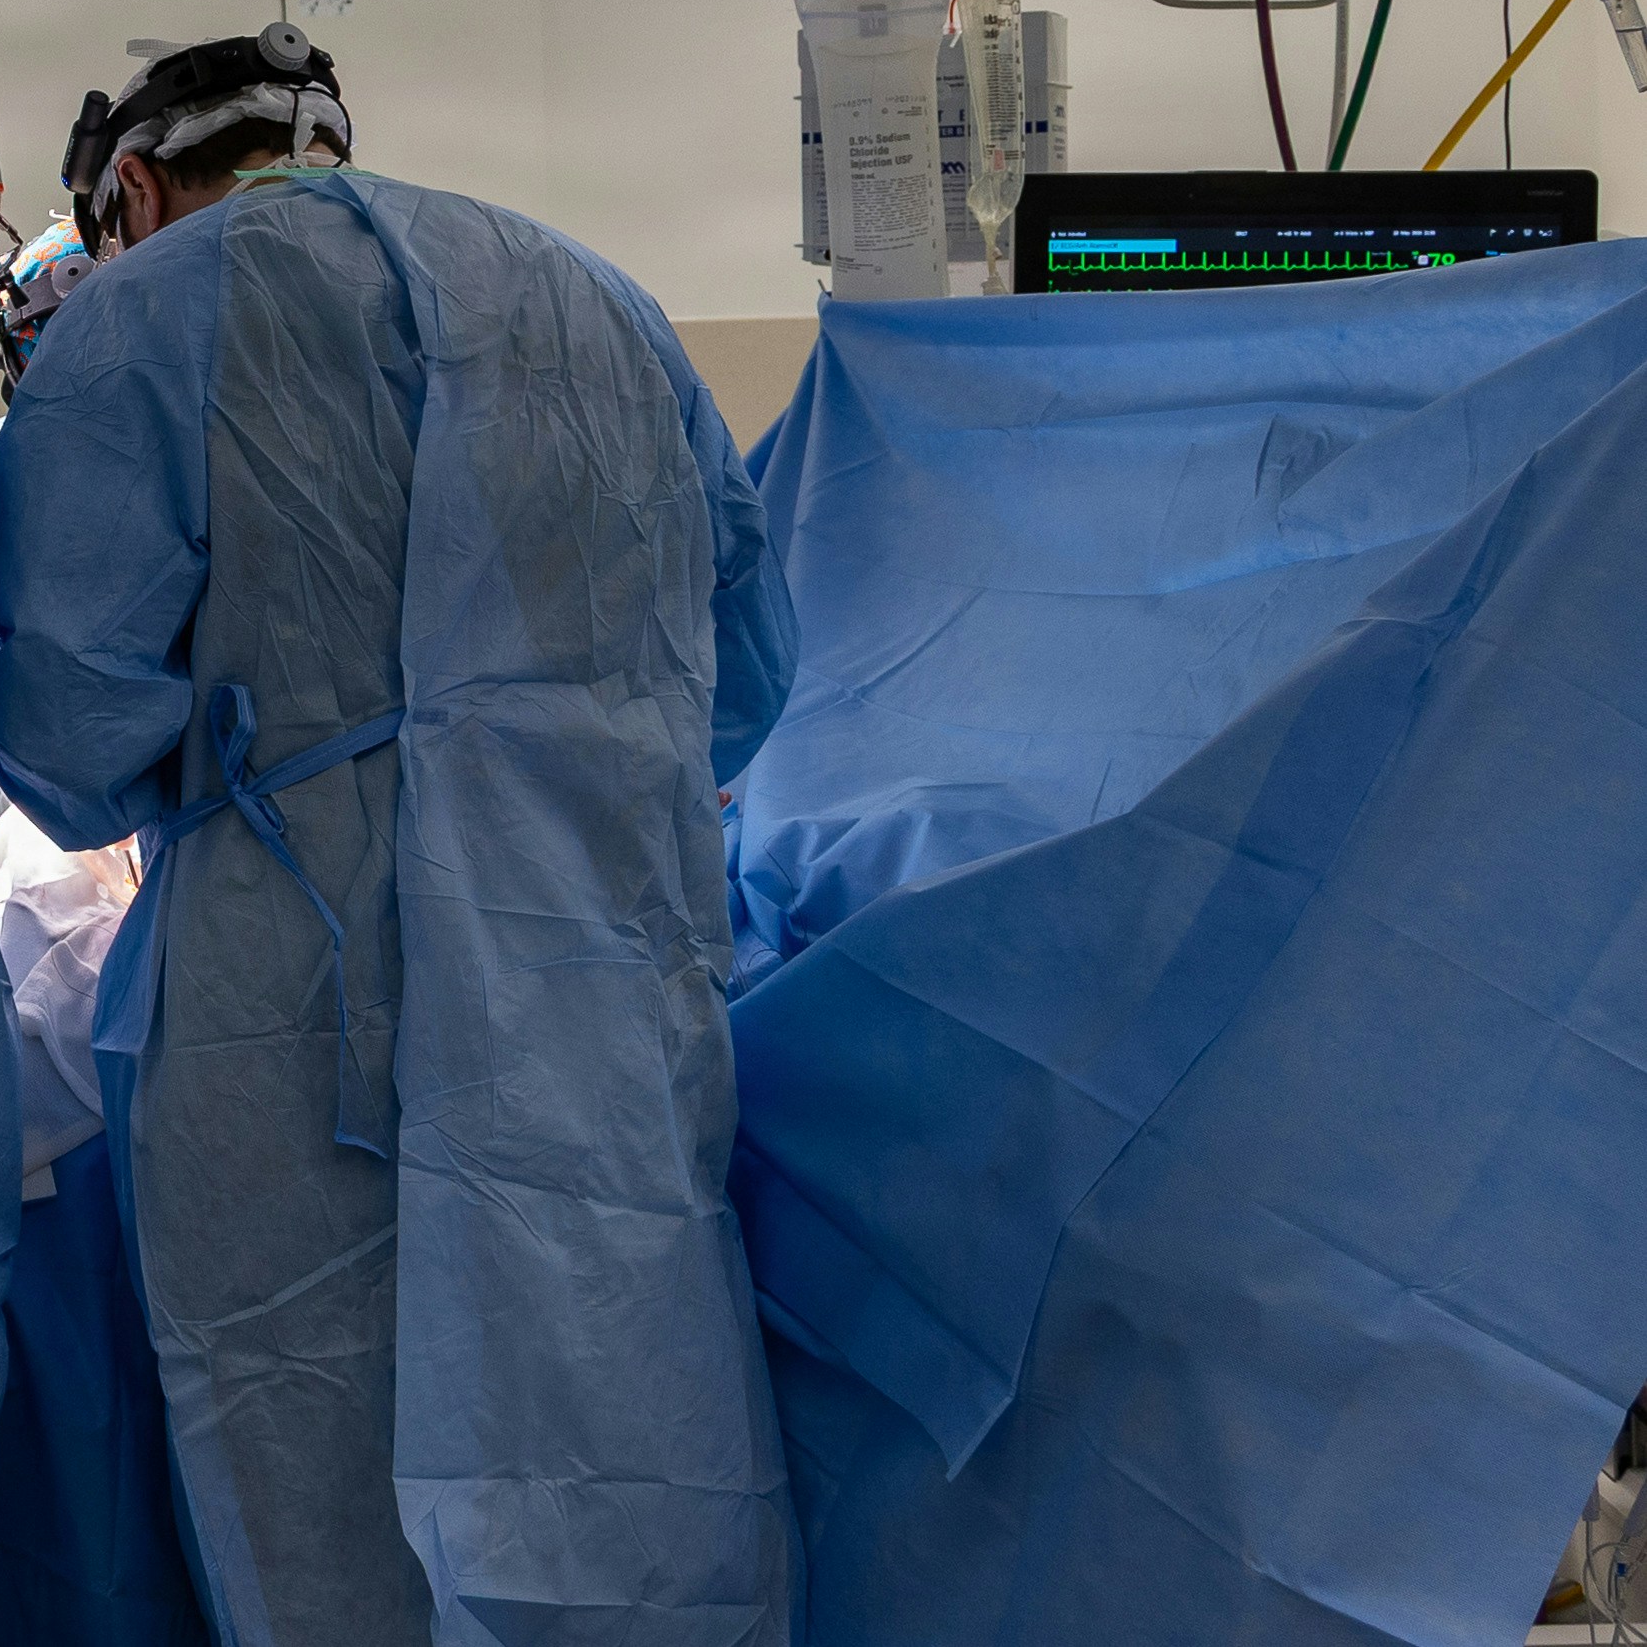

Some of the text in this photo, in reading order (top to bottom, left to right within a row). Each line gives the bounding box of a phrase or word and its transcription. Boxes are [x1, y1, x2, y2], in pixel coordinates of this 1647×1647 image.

[875, 132, 911, 145] Sodium
[849, 146, 889, 158] Chloride
[850, 155, 913, 171] Injection USP
